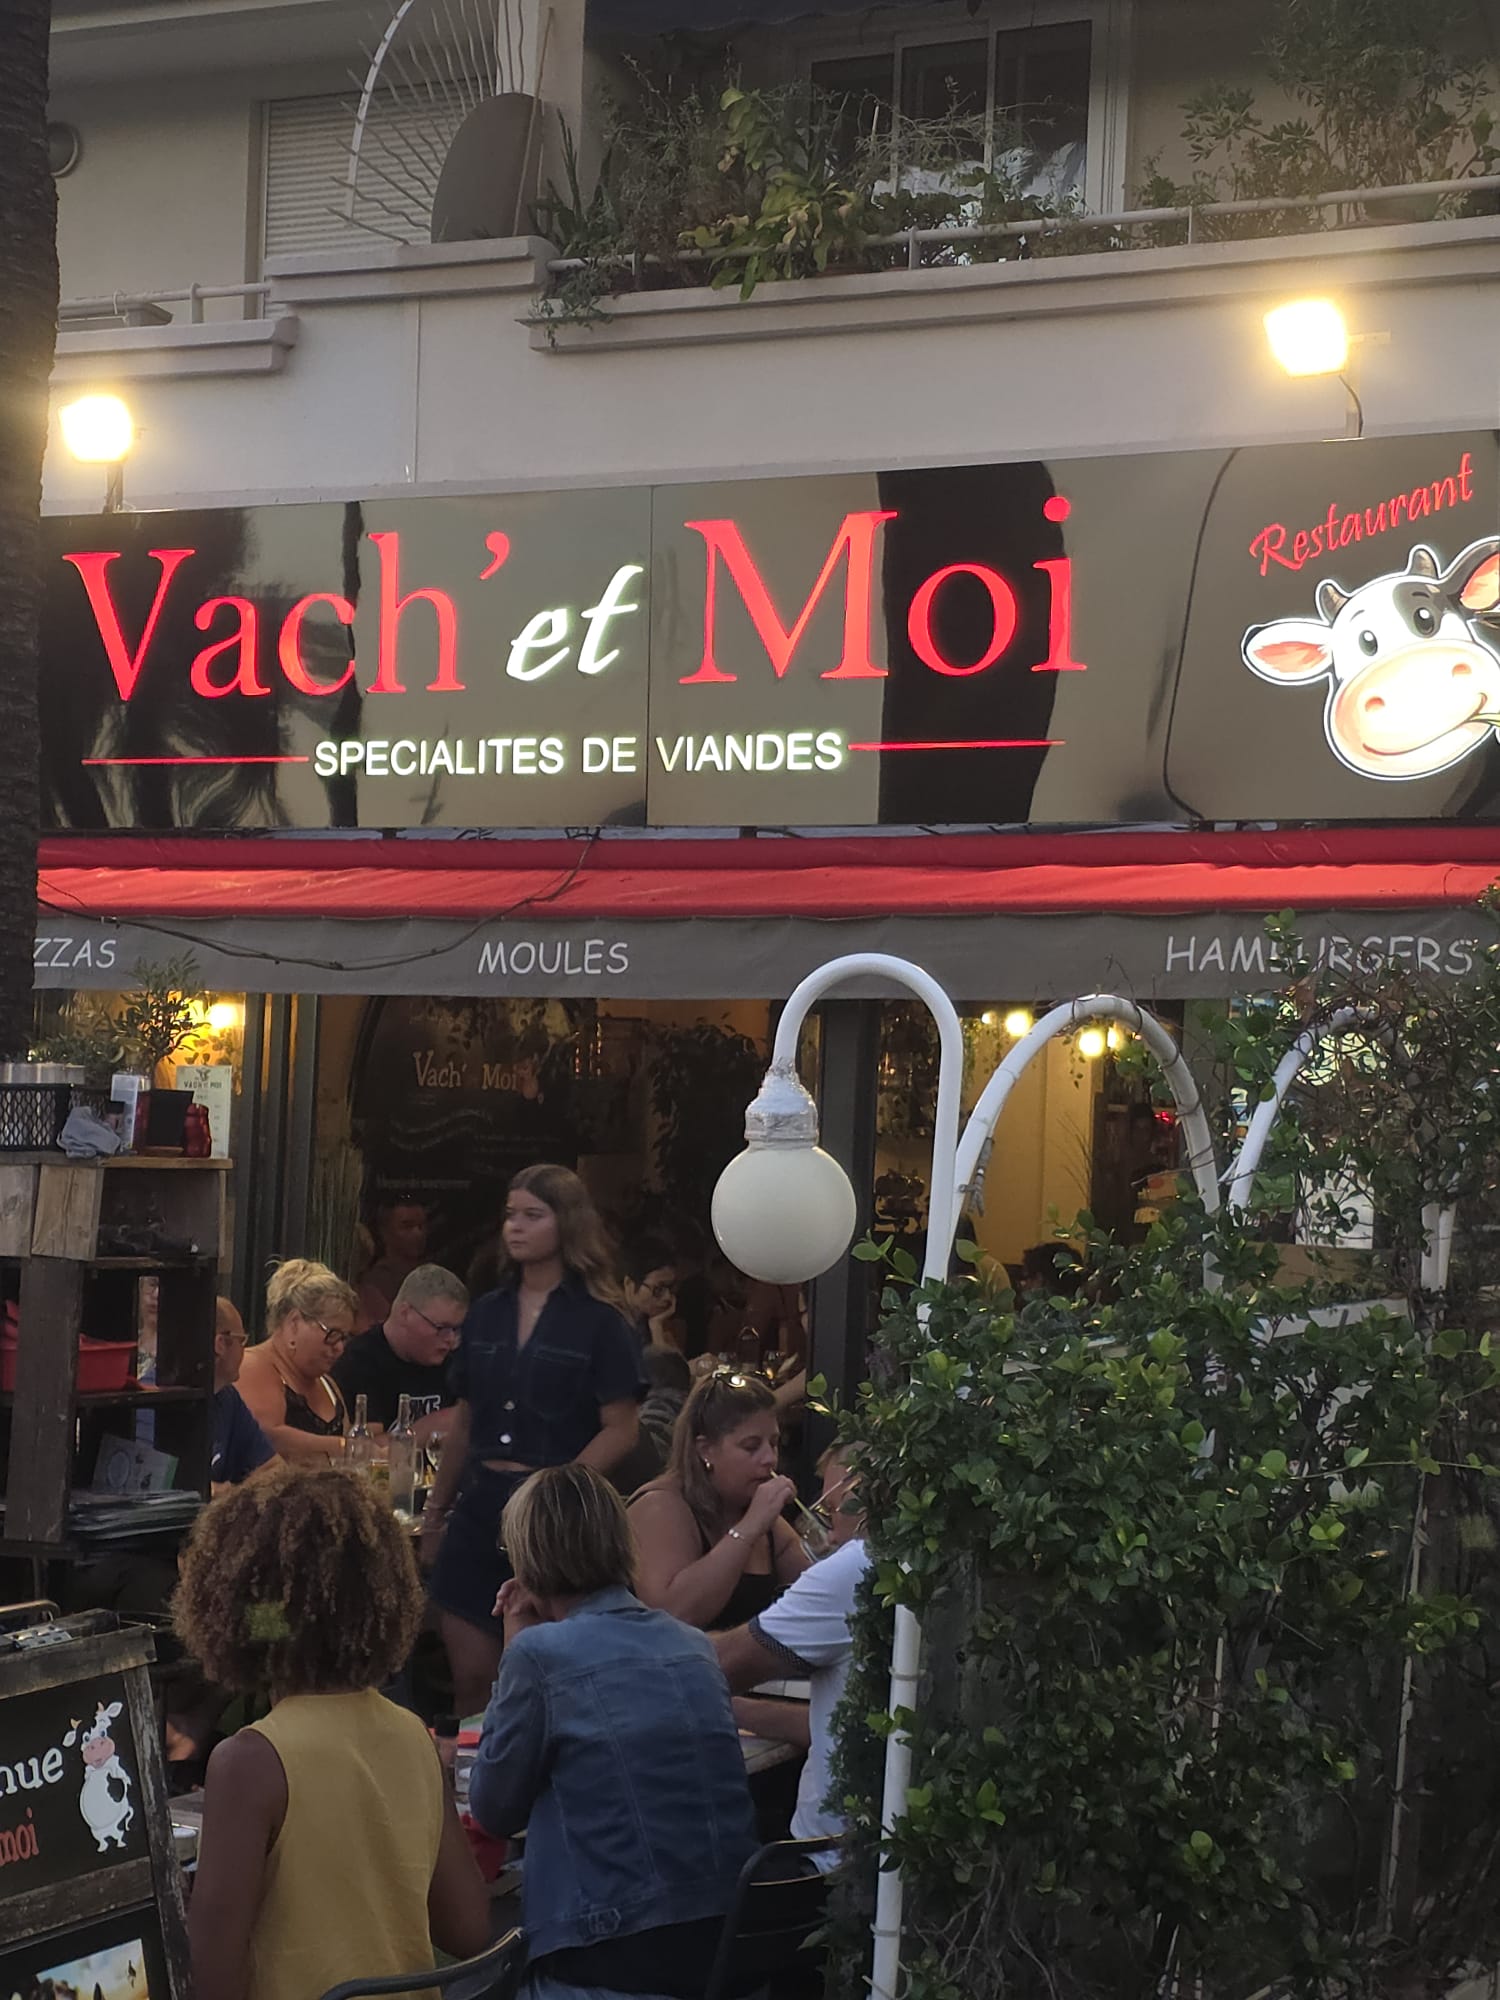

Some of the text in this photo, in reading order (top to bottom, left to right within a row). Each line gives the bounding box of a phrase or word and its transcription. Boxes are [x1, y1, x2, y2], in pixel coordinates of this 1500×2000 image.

[1248, 452, 1474, 577] Restaurant
[506, 564, 644, 682] et
[678, 495, 1088, 686] Moi
[314, 731, 844, 777] SPECIALITES DE VIANDES
[478, 940, 629, 975] MOULES
